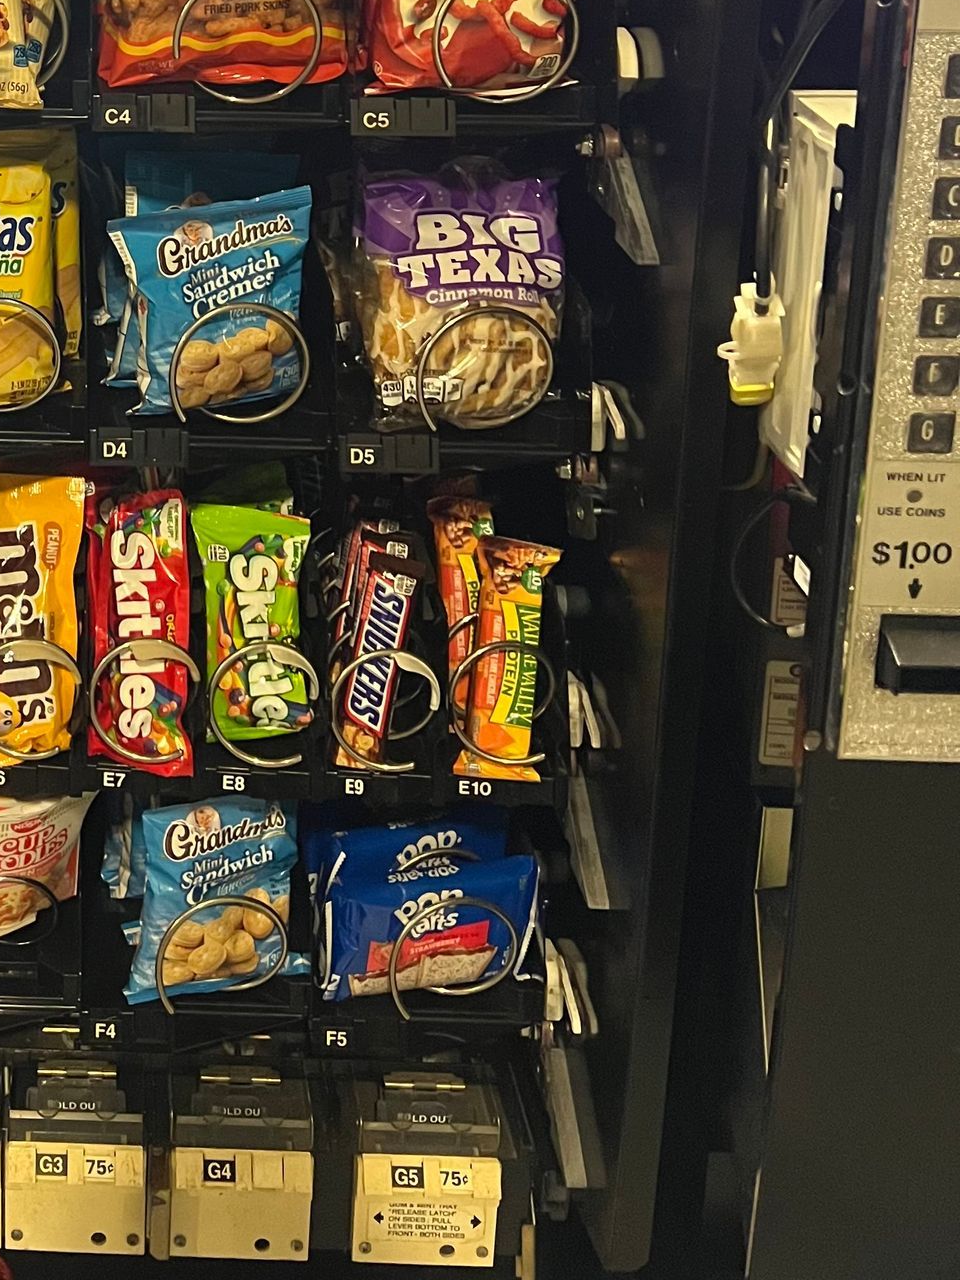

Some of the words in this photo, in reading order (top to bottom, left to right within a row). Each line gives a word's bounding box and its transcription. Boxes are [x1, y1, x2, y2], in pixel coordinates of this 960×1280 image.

[204, 3, 232, 14] FRIED
[235, 2, 261, 13] PORK
[263, 0, 290, 11] SKINS
[105, 109, 131, 124] C4
[363, 112, 389, 128] C5
[416, 213, 540, 253] BIG
[159, 216, 292, 275] Grandma's
[941, 245, 954, 265] D
[183, 250, 280, 302] Sandwich
[191, 263, 219, 284] Mini
[397, 249, 562, 289] TEXAS
[193, 272, 274, 320] Cremes
[935, 305, 947, 325] E
[929, 363, 939, 383] F
[921, 421, 935, 441] G
[103, 443, 127, 458] D4
[350, 449, 375, 464] D5
[887, 472, 925, 483] WHEN
[929, 473, 945, 483] LIT
[878, 507, 902, 517] USE
[906, 507, 946, 519] COINS
[45, 528, 59, 565] PEANUT
[218, 545, 227, 561] 210
[872, 541, 952, 570] $1.00
[402, 578, 417, 596] 250
[103, 772, 126, 788] E7
[222, 775, 245, 791] E8
[345, 780, 364, 795] E9
[459, 782, 492, 796] E10
[181, 844, 273, 890] Sandwich
[194, 854, 224, 874] Mini
[410, 937, 461, 955] STRAWBERRY
[95, 1023, 117, 1038] F4
[326, 1031, 347, 1047] F5
[40, 1155, 64, 1173] G3
[86, 1159, 114, 1175] 75¢
[208, 1162, 232, 1179] G4
[395, 1168, 419, 1186] G5
[441, 1171, 469, 1187] 75¢
